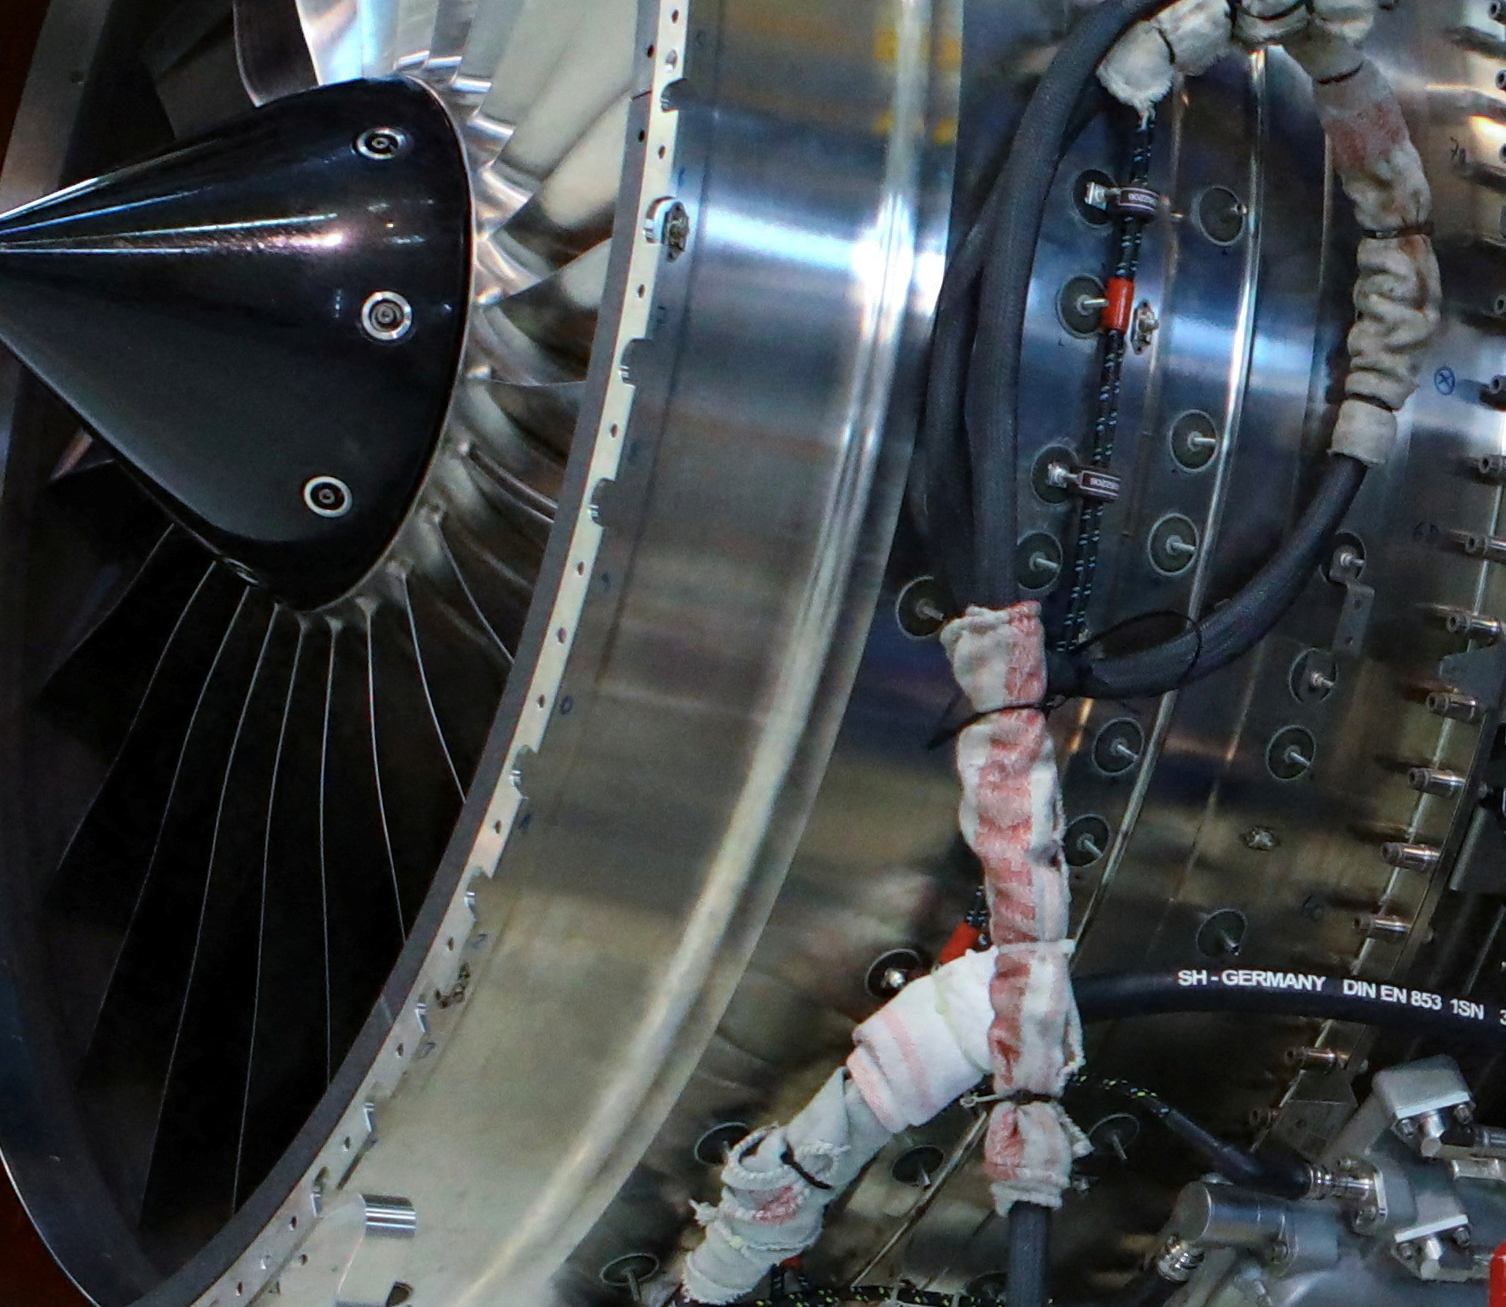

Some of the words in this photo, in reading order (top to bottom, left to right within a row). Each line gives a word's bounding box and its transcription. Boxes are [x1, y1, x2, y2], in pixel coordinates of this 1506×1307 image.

[1178, 969, 1207, 987] SH
[1221, 969, 1327, 992] GERMANY
[1343, 978, 1376, 999] DIN
[1380, 985, 1407, 1004] EN
[1410, 990, 1443, 1011] 853
[1450, 998, 1484, 1020] 1SN
